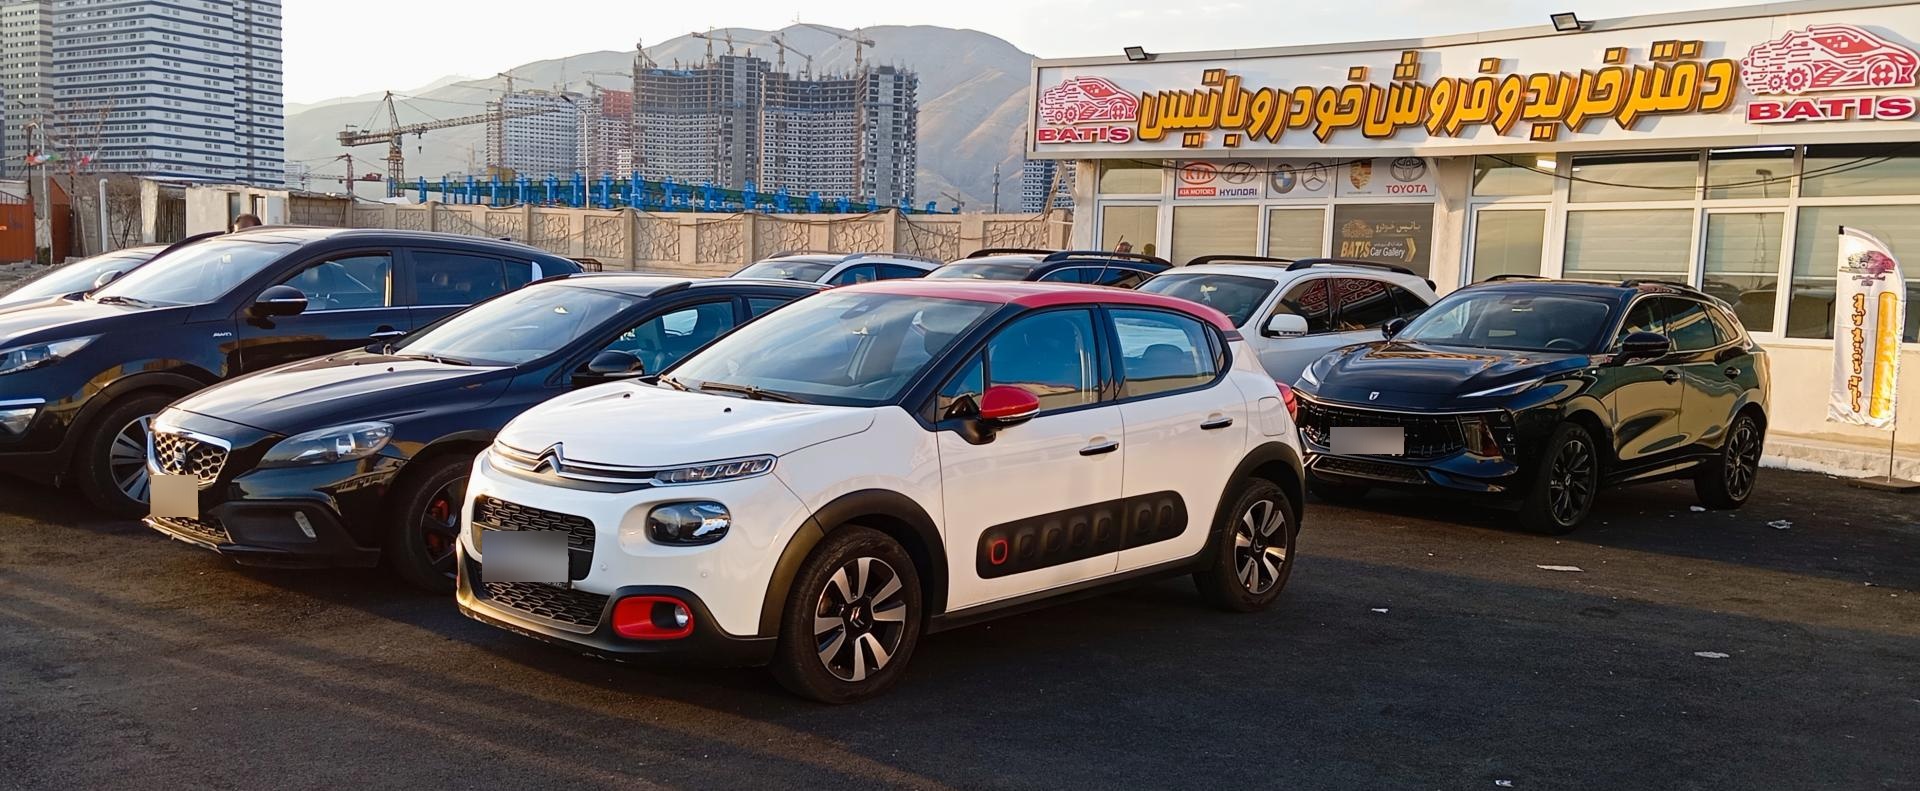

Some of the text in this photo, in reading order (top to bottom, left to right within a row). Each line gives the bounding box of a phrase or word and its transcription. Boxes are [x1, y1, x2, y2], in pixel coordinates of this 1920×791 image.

[1362, 50, 1499, 138] فروش
[1520, 47, 1628, 142] خرید
[1615, 40, 1740, 131] دفتر
[1137, 69, 1248, 148] باتیس
[1245, 66, 1368, 143] خودرو
[1747, 97, 1914, 121] BATIS
[1037, 126, 1133, 143] BATIS
[1190, 187, 1214, 195] MOTORS
[1219, 188, 1257, 196] HYUNDAI
[1386, 184, 1428, 194] TOYOTA
[1340, 240, 1371, 257] BATIS
[1370, 247, 1405, 259] Car Gallery
